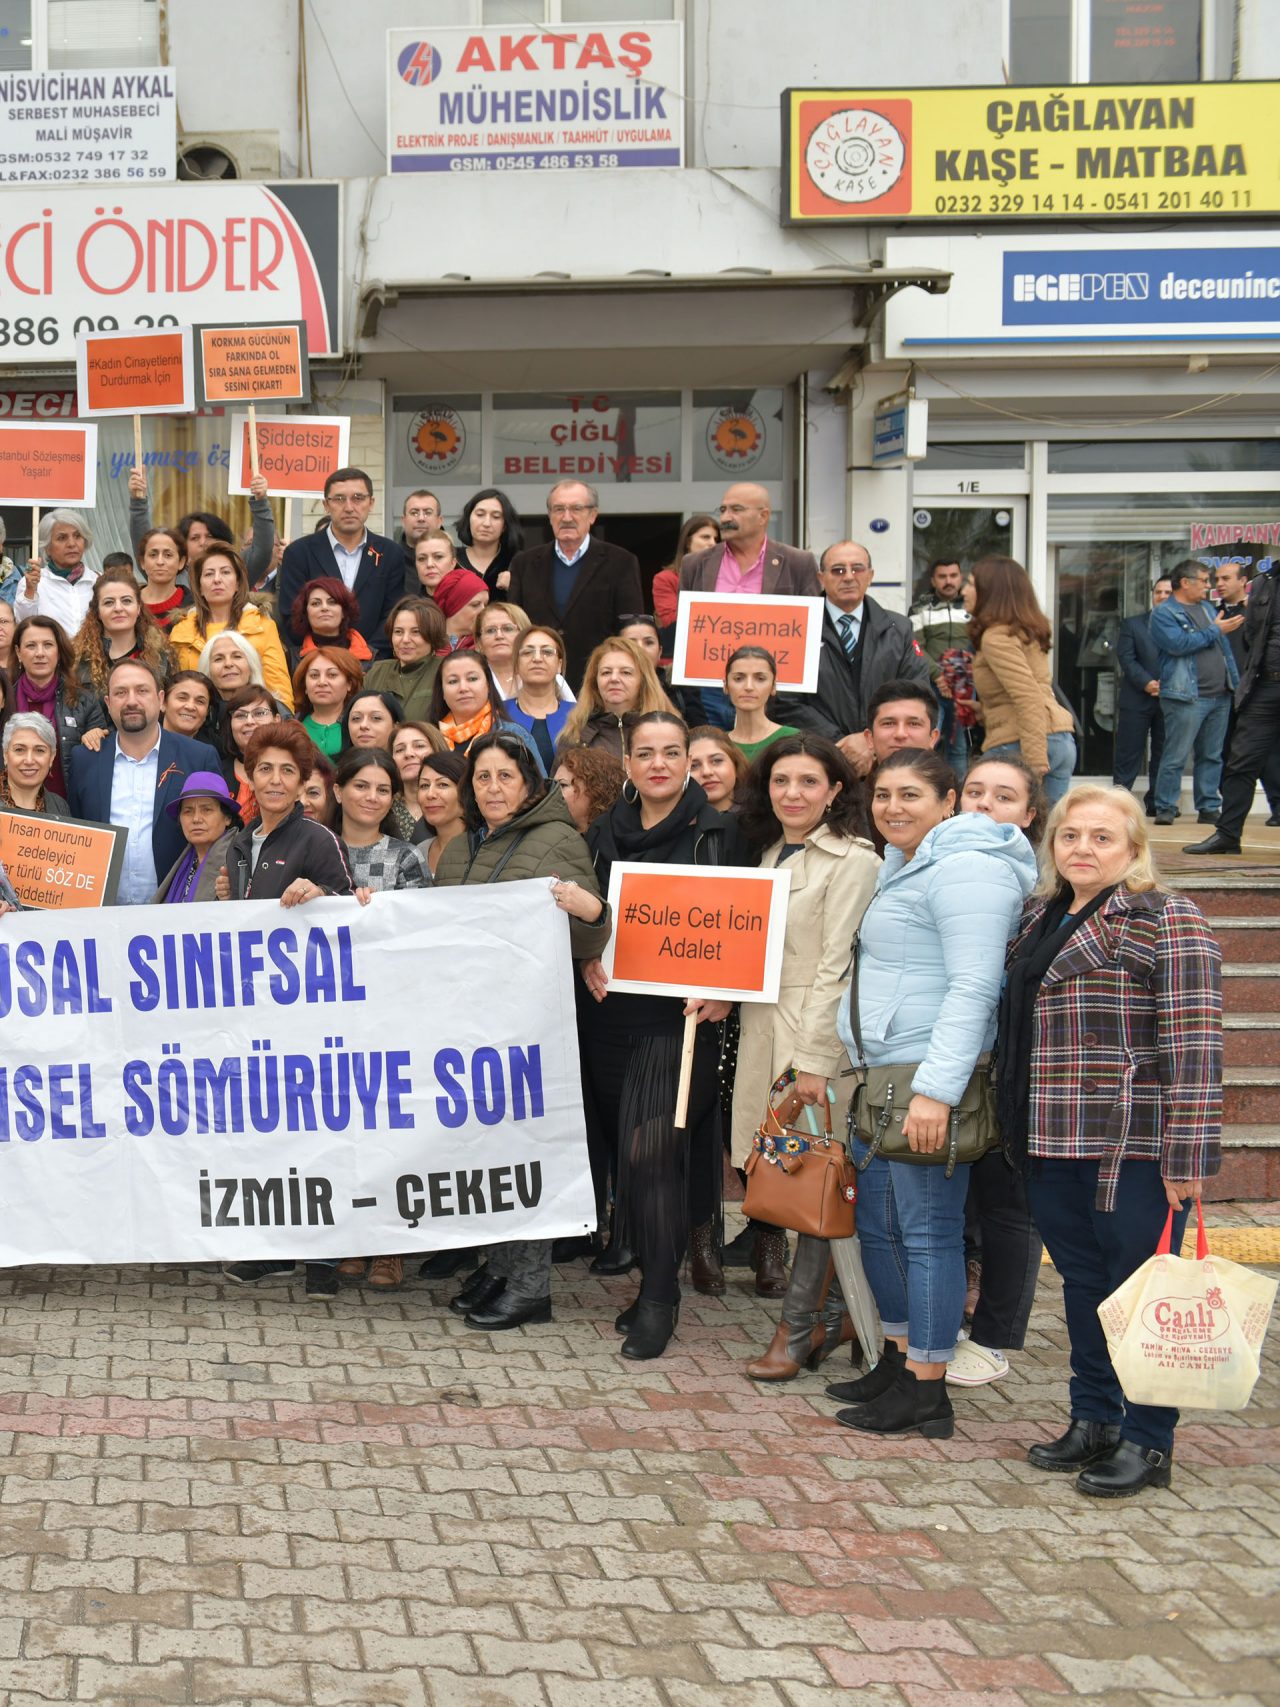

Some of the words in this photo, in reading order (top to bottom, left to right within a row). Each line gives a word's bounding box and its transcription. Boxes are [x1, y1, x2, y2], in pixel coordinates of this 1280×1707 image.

[455, 31, 653, 79] AKTAŞ
[111, 75, 174, 99] AYKAL
[7, 107, 69, 121] SERBEST
[72, 102, 161, 119] MUHASEBECİ
[438, 78, 667, 126] MÜHENDİSLİK
[986, 93, 1195, 140] ÇAĞLAYAN
[35, 126, 68, 142] MALİ
[72, 125, 133, 144] MÜŞAVİR
[396, 131, 445, 149] ELEKTRİK
[447, 134, 480, 148] PROJE
[486, 131, 555, 149] DANIŞMANLIK
[562, 128, 610, 144] TAAHHÜT
[616, 128, 672, 143] UYGULAMA
[76, 151, 103, 162] 749
[108, 150, 126, 161] 17
[130, 150, 149, 161] 32
[449, 157, 492, 171] GSM:
[495, 156, 536, 170] 0545
[539, 155, 570, 169] 486
[574, 154, 594, 168] 53
[598, 154, 619, 168] 58
[934, 148, 1040, 188] KAŞE
[1075, 143, 1248, 180] MATBAA
[94, 168, 121, 179] 386
[126, 167, 145, 178] 56
[149, 166, 167, 178] 59
[934, 195, 982, 214] 0232
[989, 194, 1024, 212] 329
[1032, 193, 1055, 211] 14
[1062, 193, 1084, 210] 14
[1103, 192, 1151, 210] 0541
[1157, 191, 1191, 209] 201
[1200, 191, 1224, 208] 40
[1233, 190, 1253, 207] 11
[76, 206, 285, 295] ÖNDER
[1013, 272, 1149, 302] EGEPEN
[211, 337, 247, 348] KORKMA
[226, 351, 267, 362] FARKINDA
[269, 350, 280, 360] OL
[100, 373, 152, 387] Durdurmak
[153, 372, 171, 387] İçin
[209, 367, 227, 378] SIRA
[229, 366, 251, 377] SANA
[253, 364, 297, 376] GELMEDEN
[252, 380, 282, 393] ÇIKART!
[504, 452, 673, 475] BELEDİYESİ
[957, 481, 980, 493] 1/E
[693, 614, 802, 640] #Yaşamak
[8, 816, 41, 839] İnsan
[43, 827, 93, 848] onurunu
[17, 844, 76, 866] zedeleyici
[16, 863, 43, 881] türlü
[45, 866, 72, 887] SÖZ
[75, 873, 96, 891] DE
[624, 903, 681, 928] #Sule
[687, 906, 722, 929] Cet
[728, 904, 763, 932] İcin
[658, 936, 722, 961] Adalet
[127, 924, 366, 1013] SINIFSAL
[122, 1036, 414, 1137] SÖMÜRÜYE
[432, 1043, 546, 1126] SON
[198, 1167, 336, 1229] İZMİR
[351, 1197, 378, 1209] -
[394, 1160, 543, 1230] ÇEKEV
